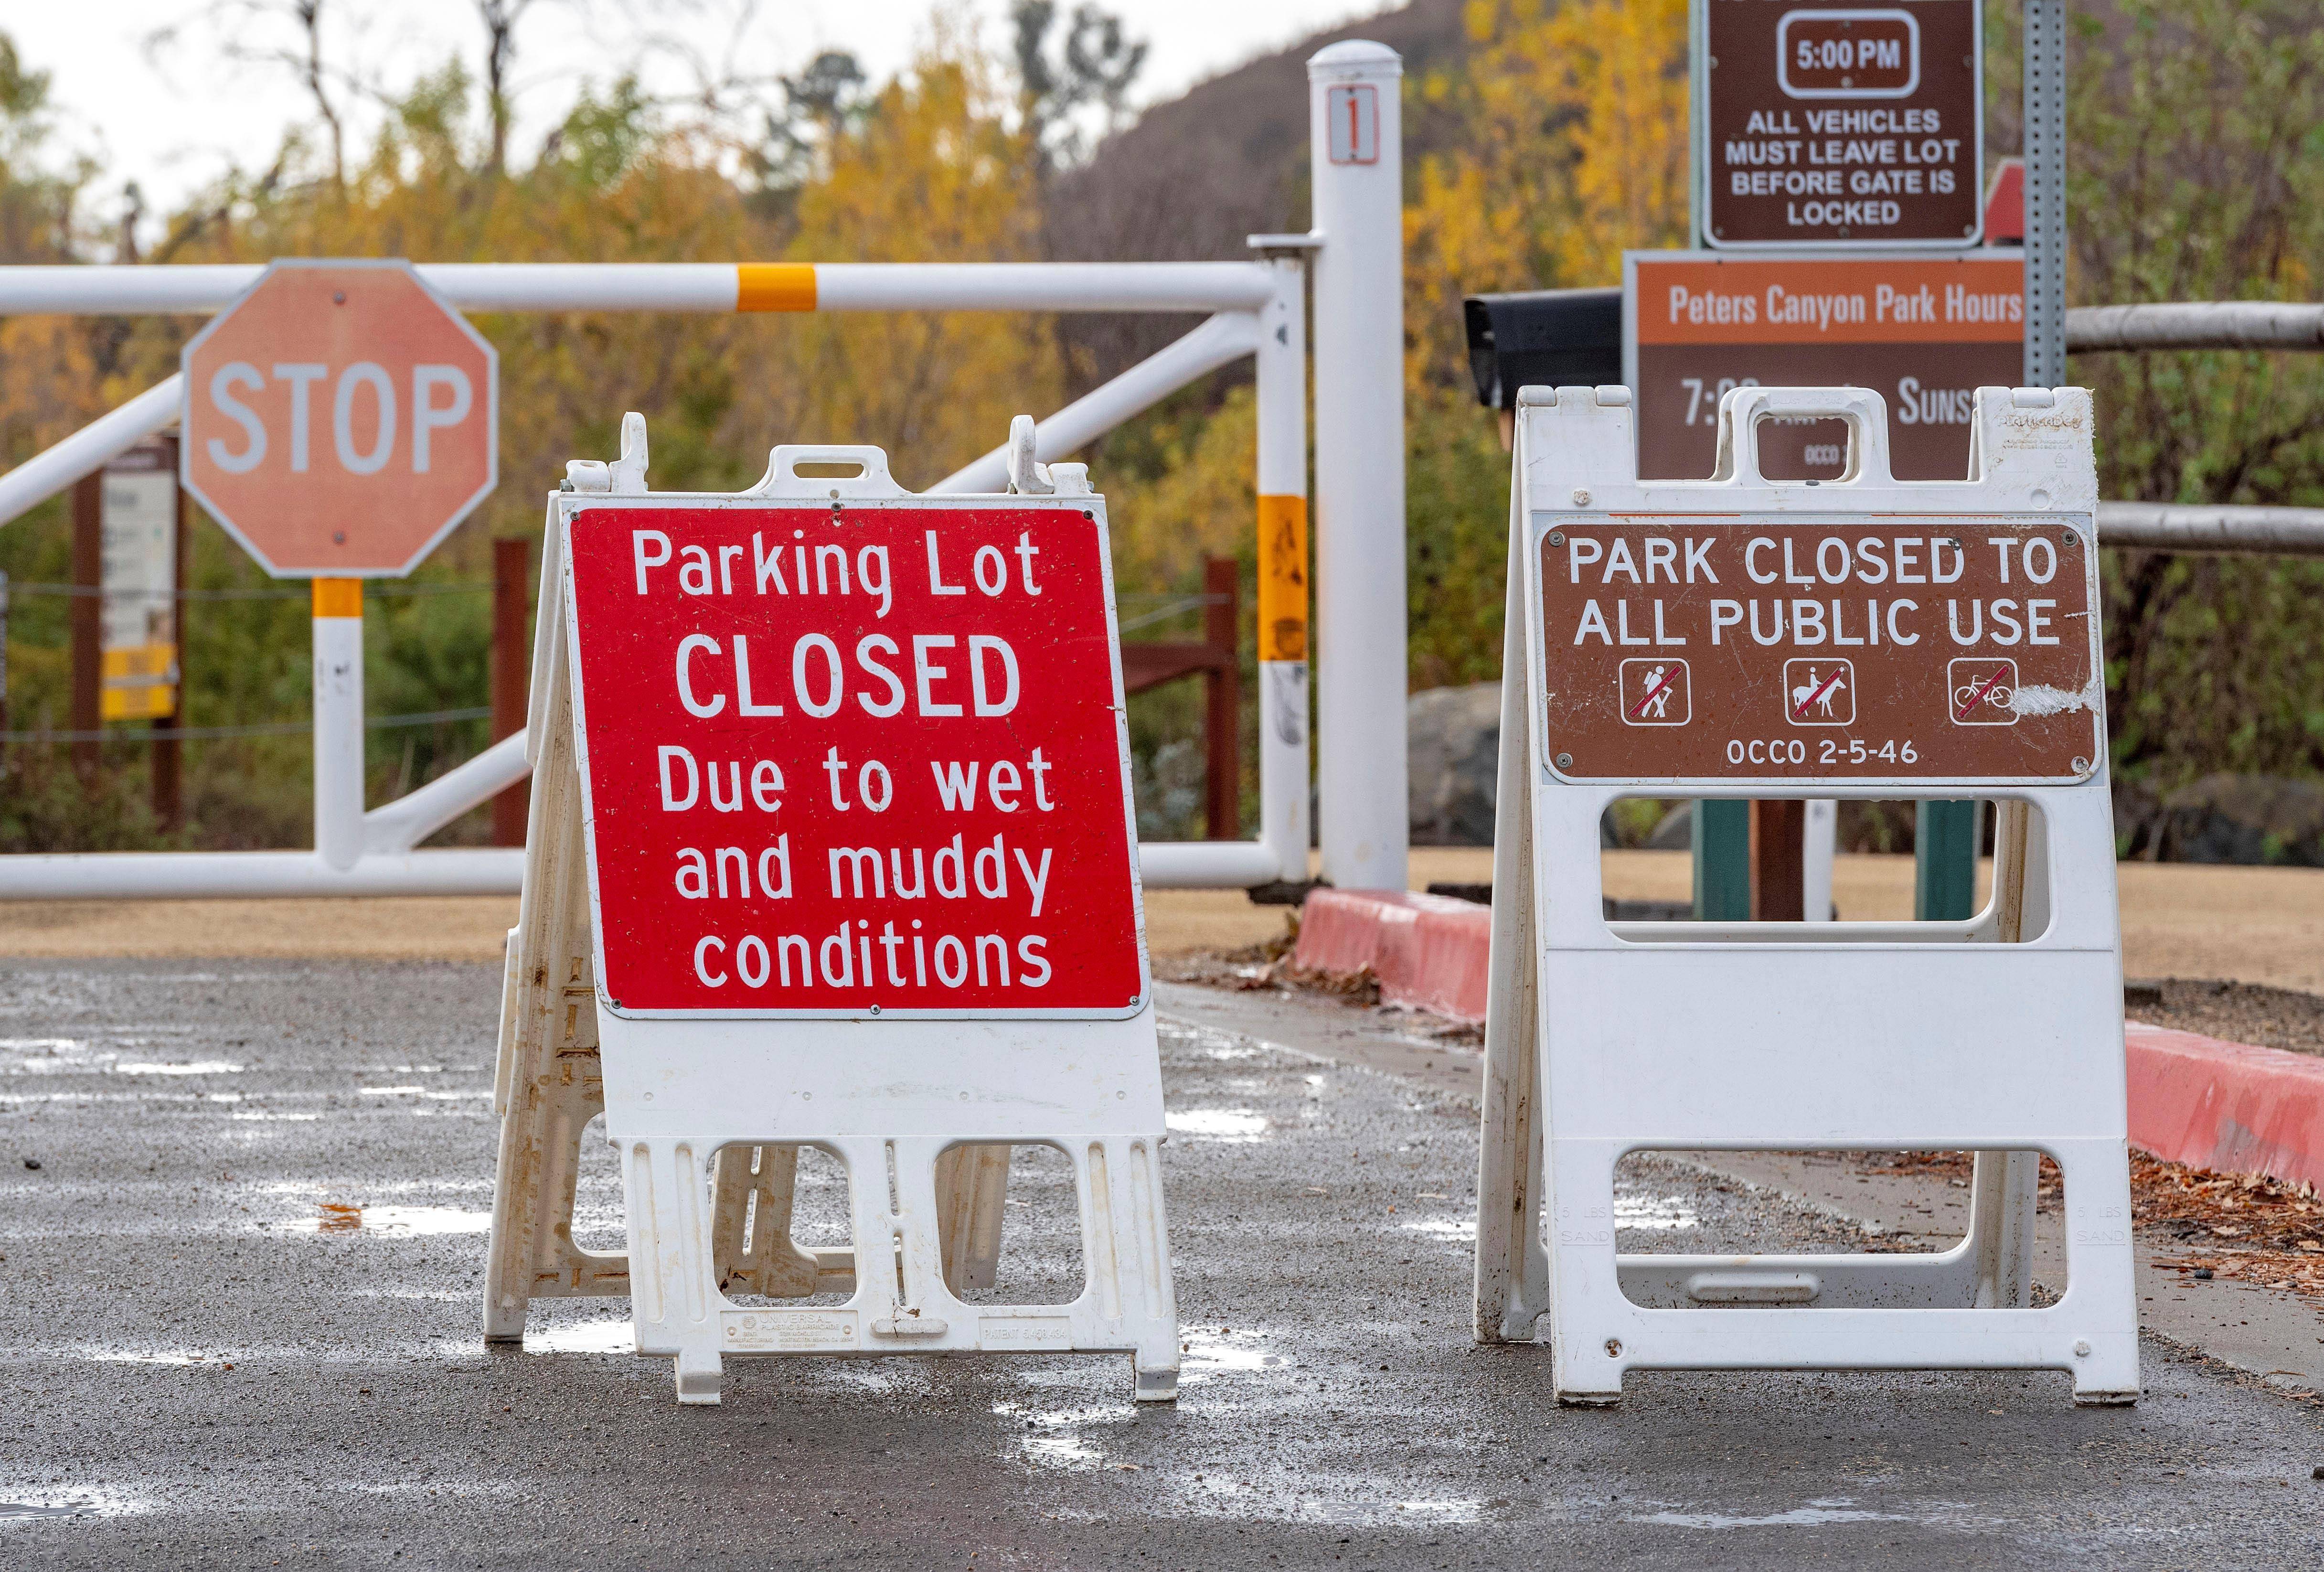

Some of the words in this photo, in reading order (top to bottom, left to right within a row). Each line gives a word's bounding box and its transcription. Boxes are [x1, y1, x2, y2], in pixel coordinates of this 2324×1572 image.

[1798, 40, 1853, 69] 5:00
[1859, 40, 1899, 68] PM
[1347, 97, 1359, 151] 1
[1747, 111, 1799, 133] ALL
[1806, 109, 1940, 133] VEHICLES
[1726, 141, 1801, 164] MUST
[1810, 140, 1896, 163] LEAVE
[1904, 139, 1959, 163] LOT
[1732, 171, 1842, 194] BEFORE
[1850, 171, 1921, 194] GATE
[1930, 170, 1955, 193] IS
[1788, 201, 1900, 225] LOCKED
[1670, 286, 1757, 323] Peters
[1767, 285, 1865, 331] Canyon
[1876, 285, 1935, 322] Park
[1946, 284, 2022, 322] Hours
[1898, 376, 1976, 424] SUNS
[207, 362, 471, 475] STOP
[633, 530, 892, 618] Parking
[926, 530, 1041, 596] Lot
[1570, 538, 1719, 583] PARK
[1745, 537, 1964, 584] CLOSED
[1989, 537, 2057, 584] TO
[1574, 599, 1686, 645] ALL
[1711, 599, 1919, 645] PUBLIC
[1948, 599, 2059, 645] USE
[676, 633, 1019, 718] CLOSED
[1727, 740, 1805, 764] OCCO
[1820, 740, 1918, 763] 2-5-46
[658, 746, 784, 812] Due
[823, 746, 893, 812] to
[931, 747, 1054, 812] wet
[675, 833, 792, 899] and
[829, 833, 1052, 917] muddy
[694, 921, 1051, 988] conditions
[1584, 1206, 1606, 1218] LBS
[2099, 1206, 2121, 1218] LBS
[1561, 1230, 1610, 1242] SAND
[2077, 1230, 2125, 1241] SAND
[758, 1314, 832, 1323] UNIVERSAL
[983, 1328, 1019, 1339] PATENT
